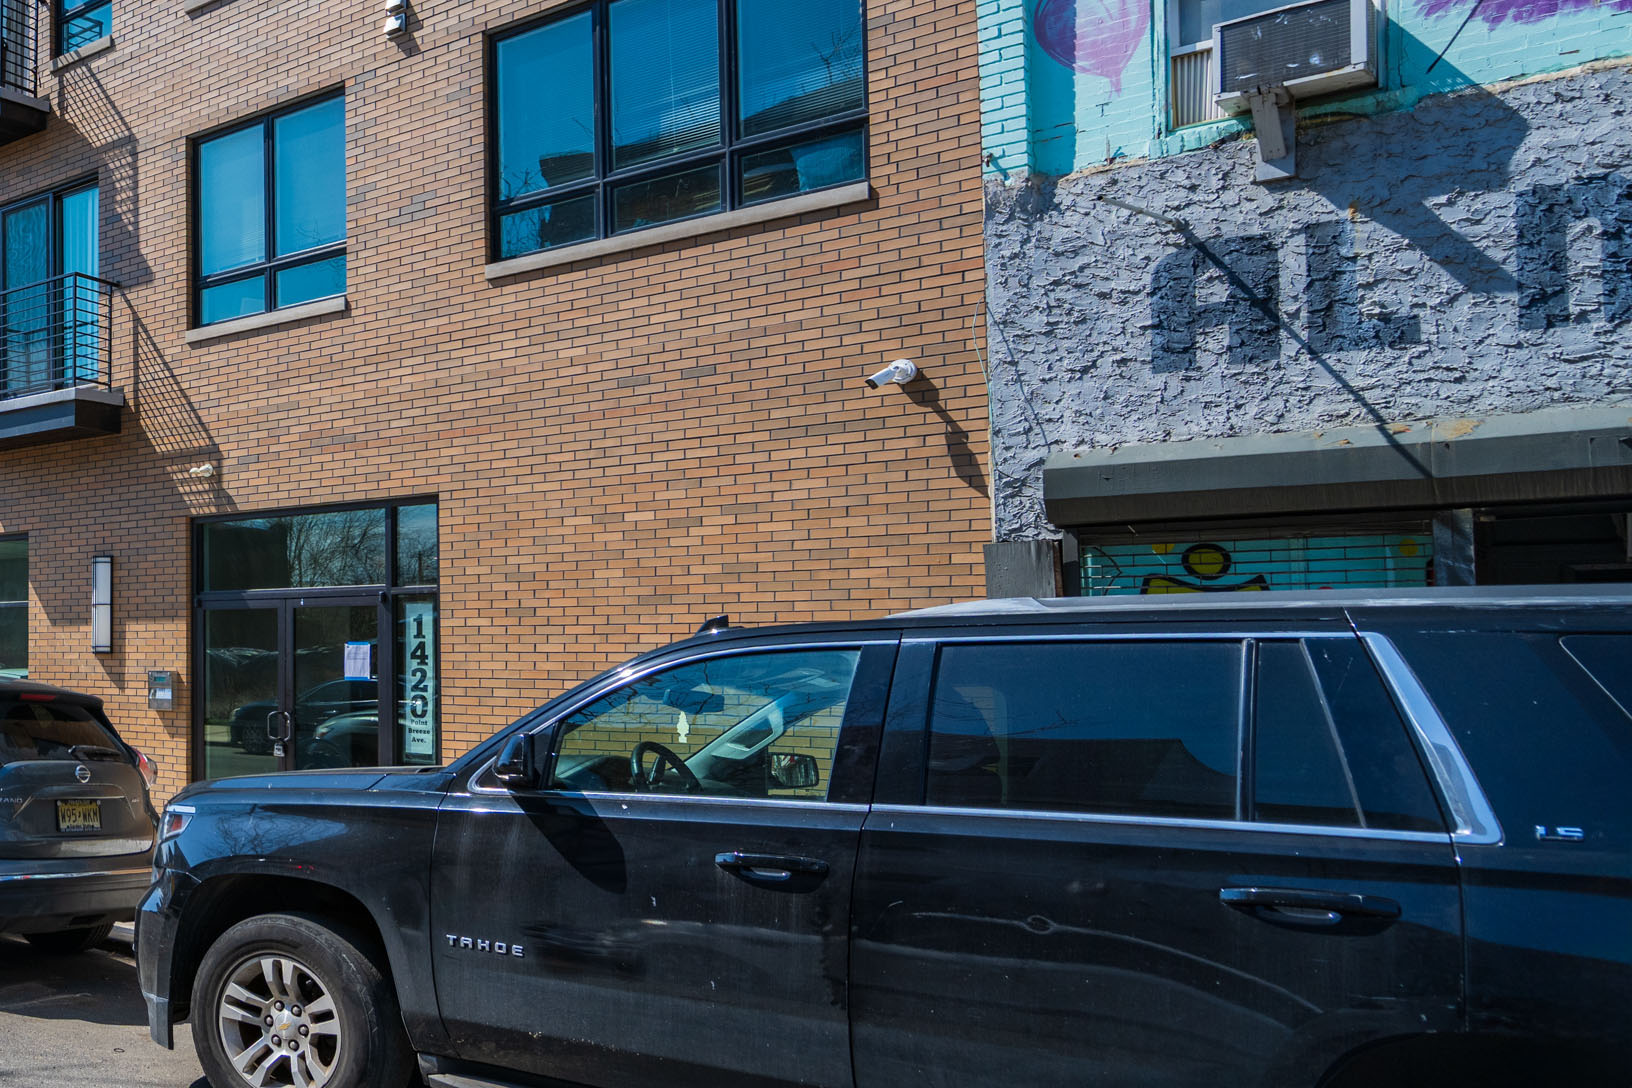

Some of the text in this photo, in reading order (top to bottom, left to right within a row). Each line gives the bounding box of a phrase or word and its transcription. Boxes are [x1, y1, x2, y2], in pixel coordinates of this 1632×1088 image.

[410, 613, 429, 719] 1420
[1534, 824, 1585, 842] LS
[446, 934, 525, 957] TAHOE
